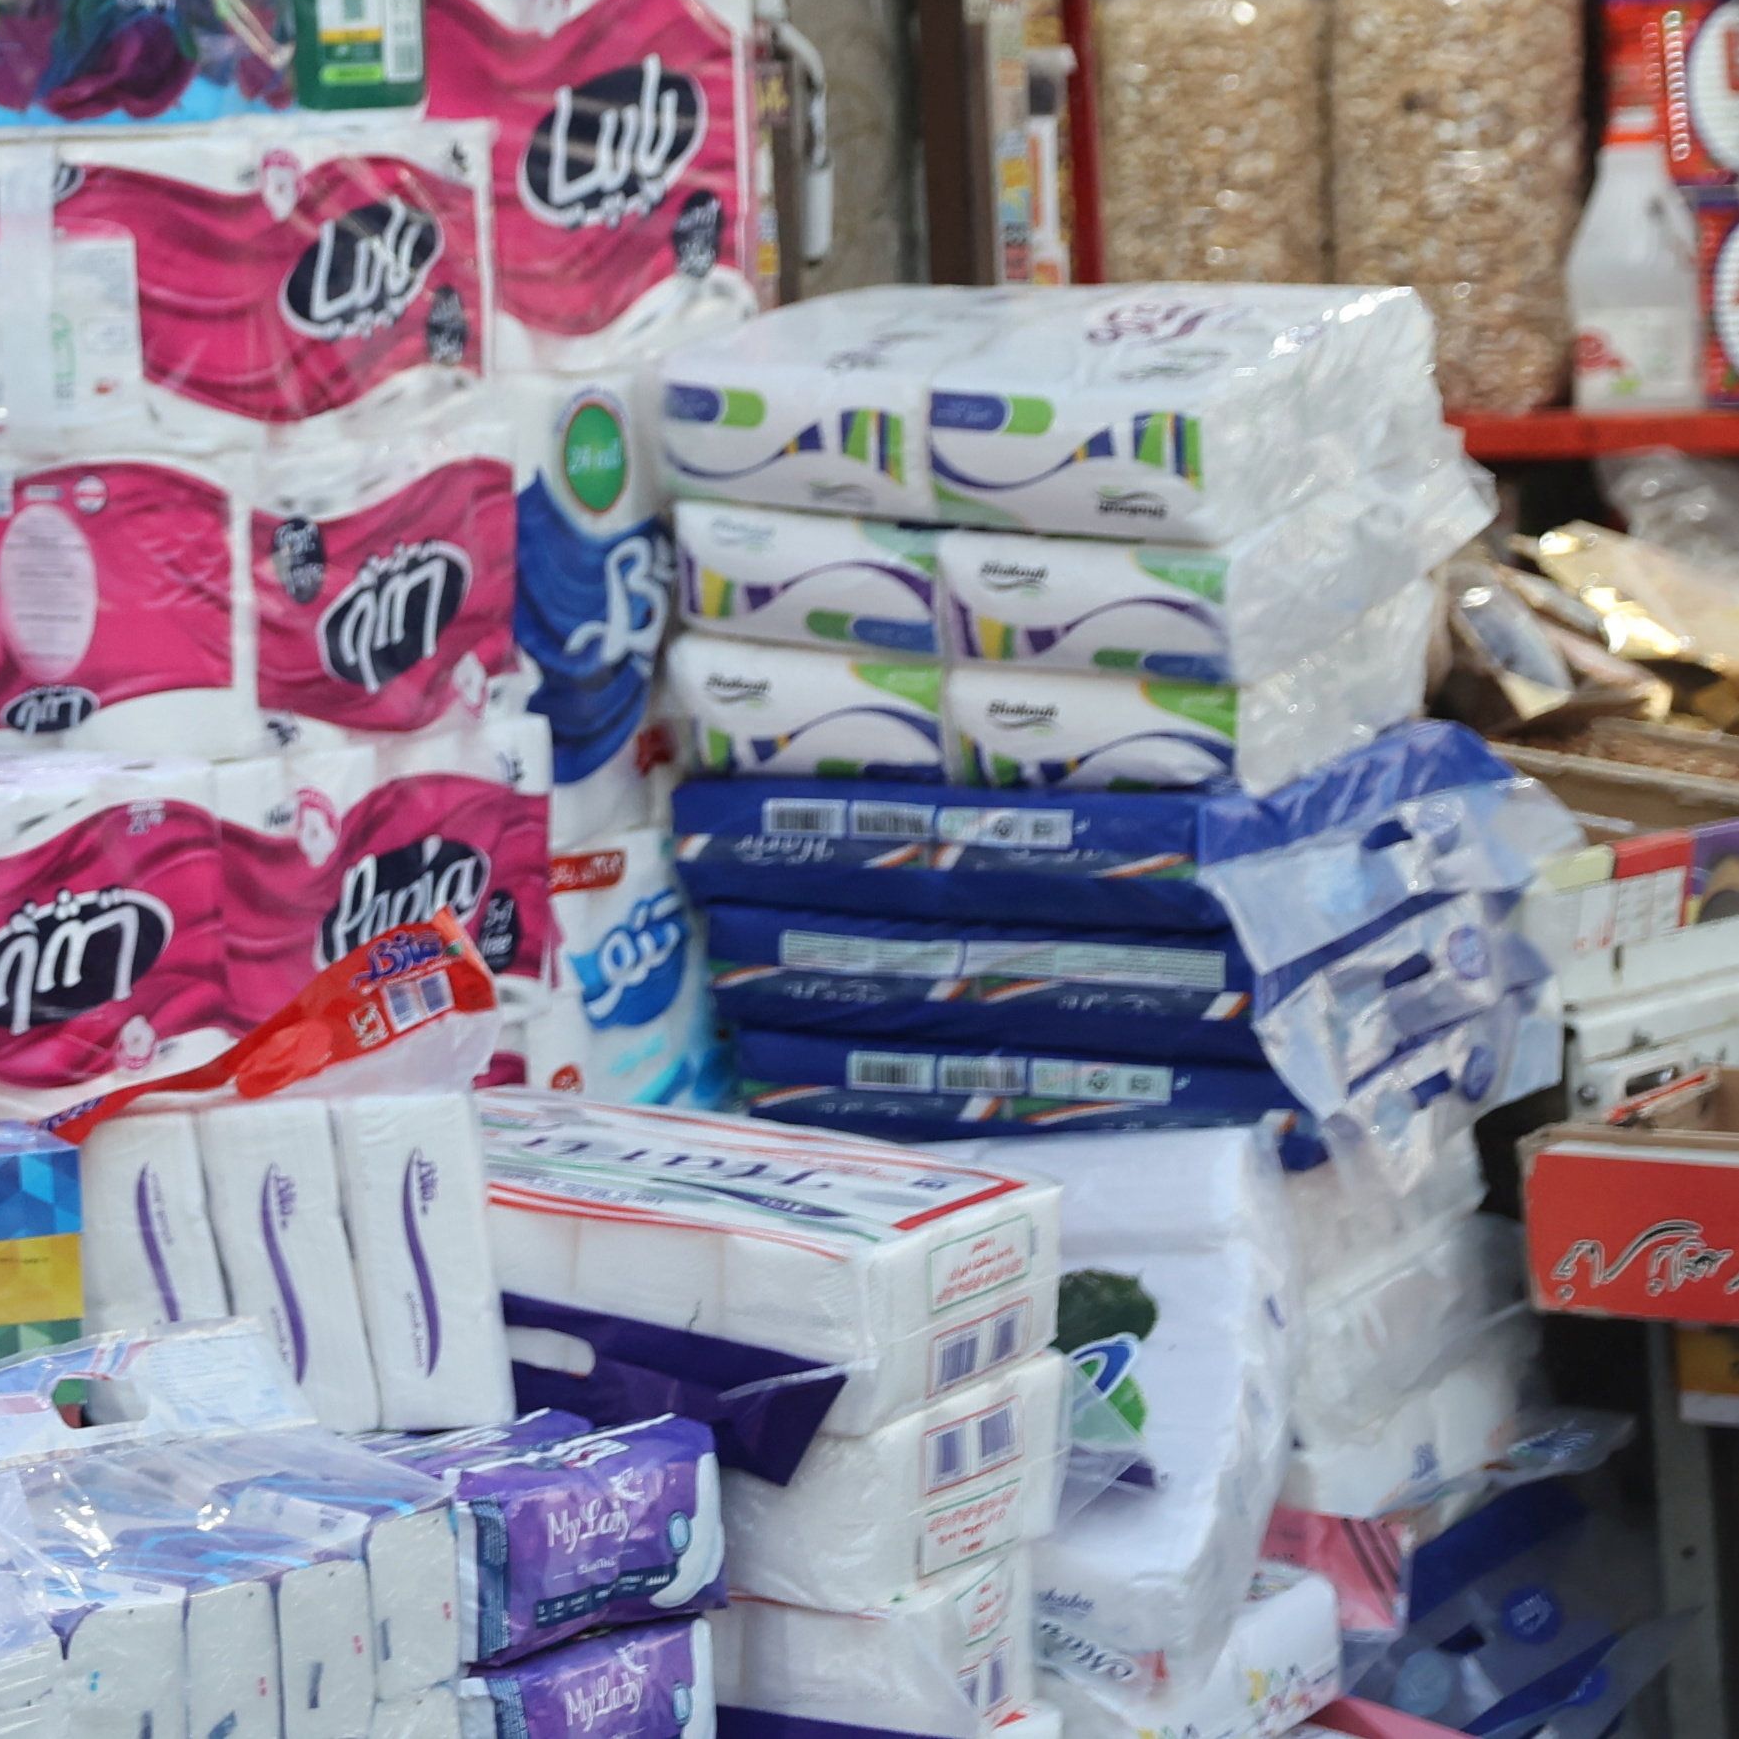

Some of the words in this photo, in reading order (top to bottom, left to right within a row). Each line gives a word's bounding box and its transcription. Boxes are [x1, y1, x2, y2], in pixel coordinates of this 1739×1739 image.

[1551, 1218, 1704, 1303] خرمای
[546, 1510, 582, 1555] My
[580, 1499, 634, 1543] Lady
[565, 1689, 593, 1732] My
[591, 1674, 645, 1716] Lady
